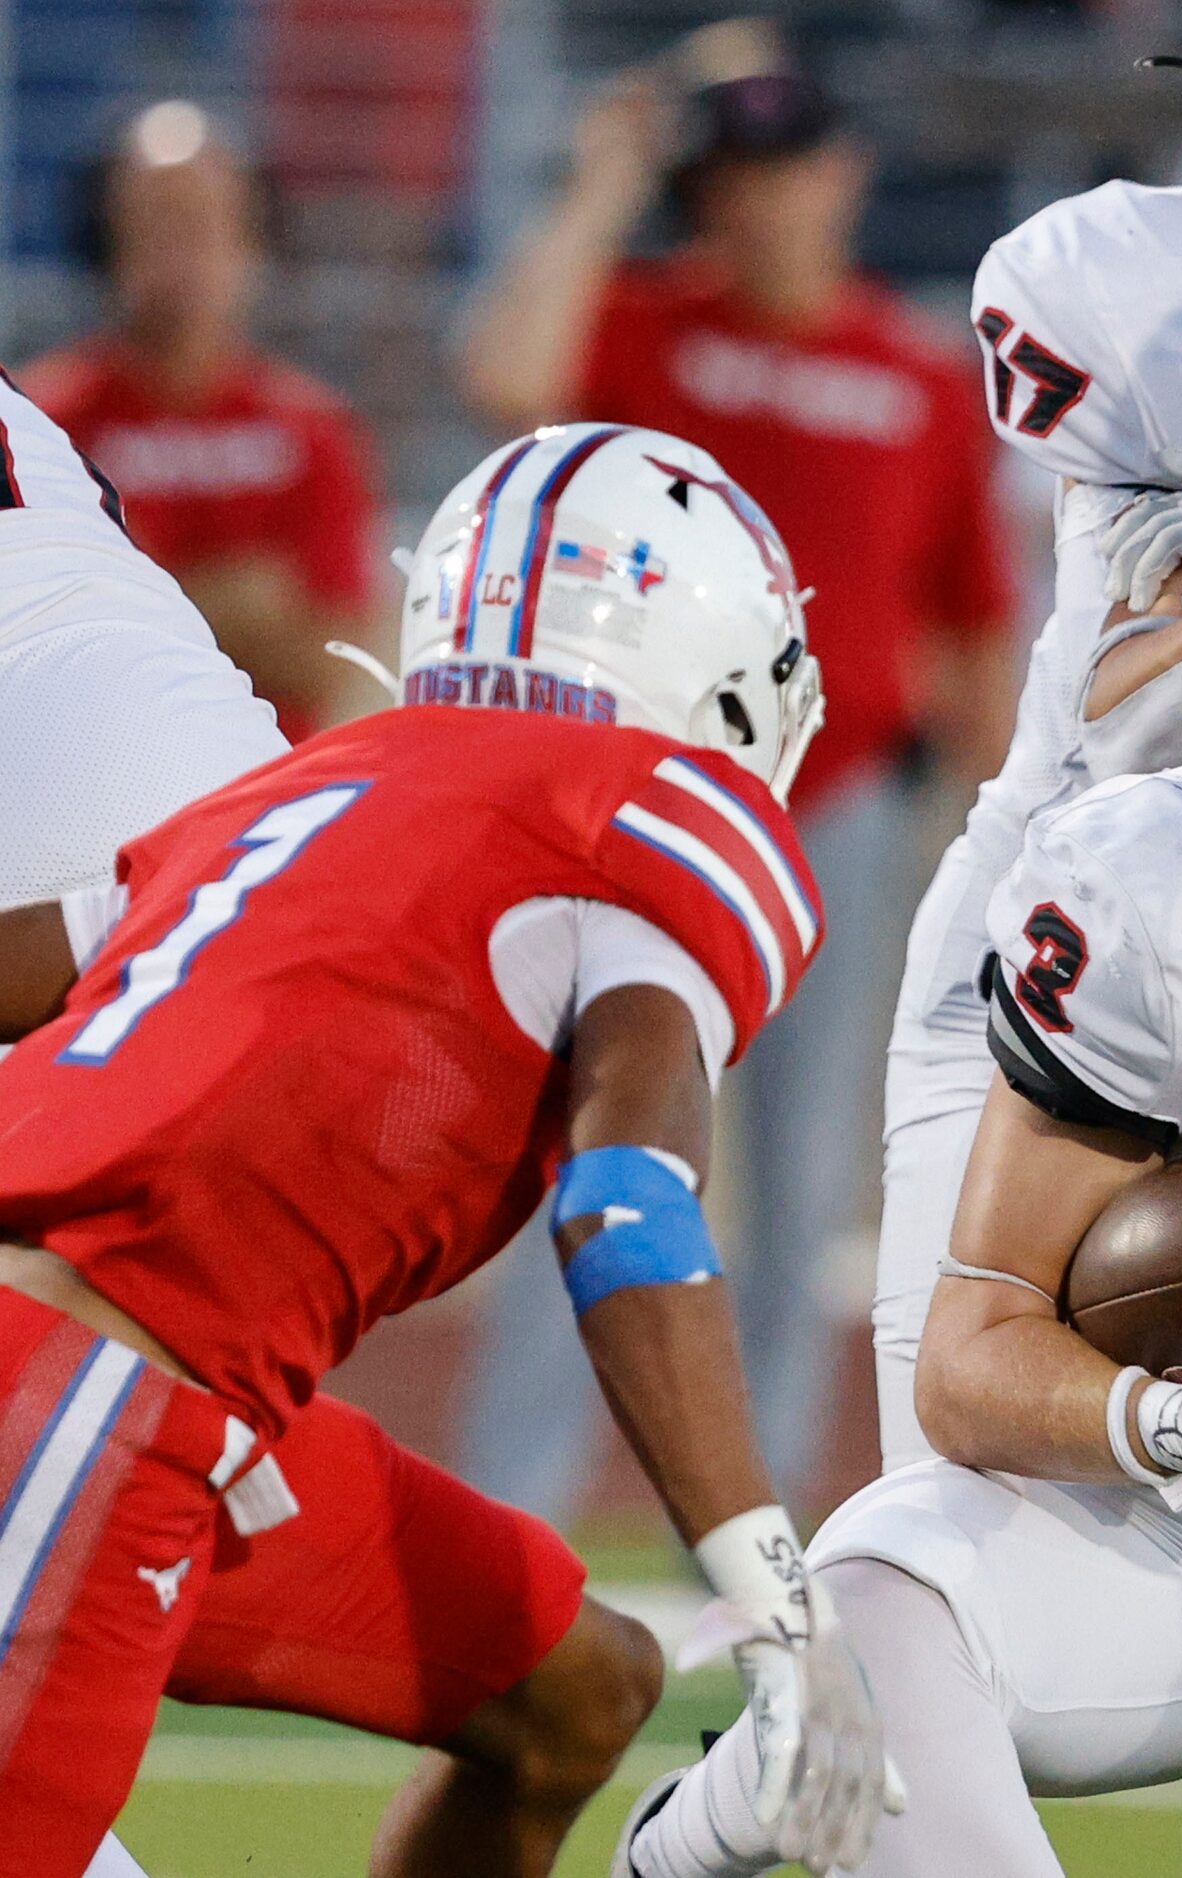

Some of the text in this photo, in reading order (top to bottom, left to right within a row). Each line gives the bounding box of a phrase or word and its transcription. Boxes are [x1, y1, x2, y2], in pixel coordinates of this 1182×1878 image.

[976, 306, 1094, 439] 17
[482, 571, 516, 606] LC
[54, 776, 374, 1068] 1
